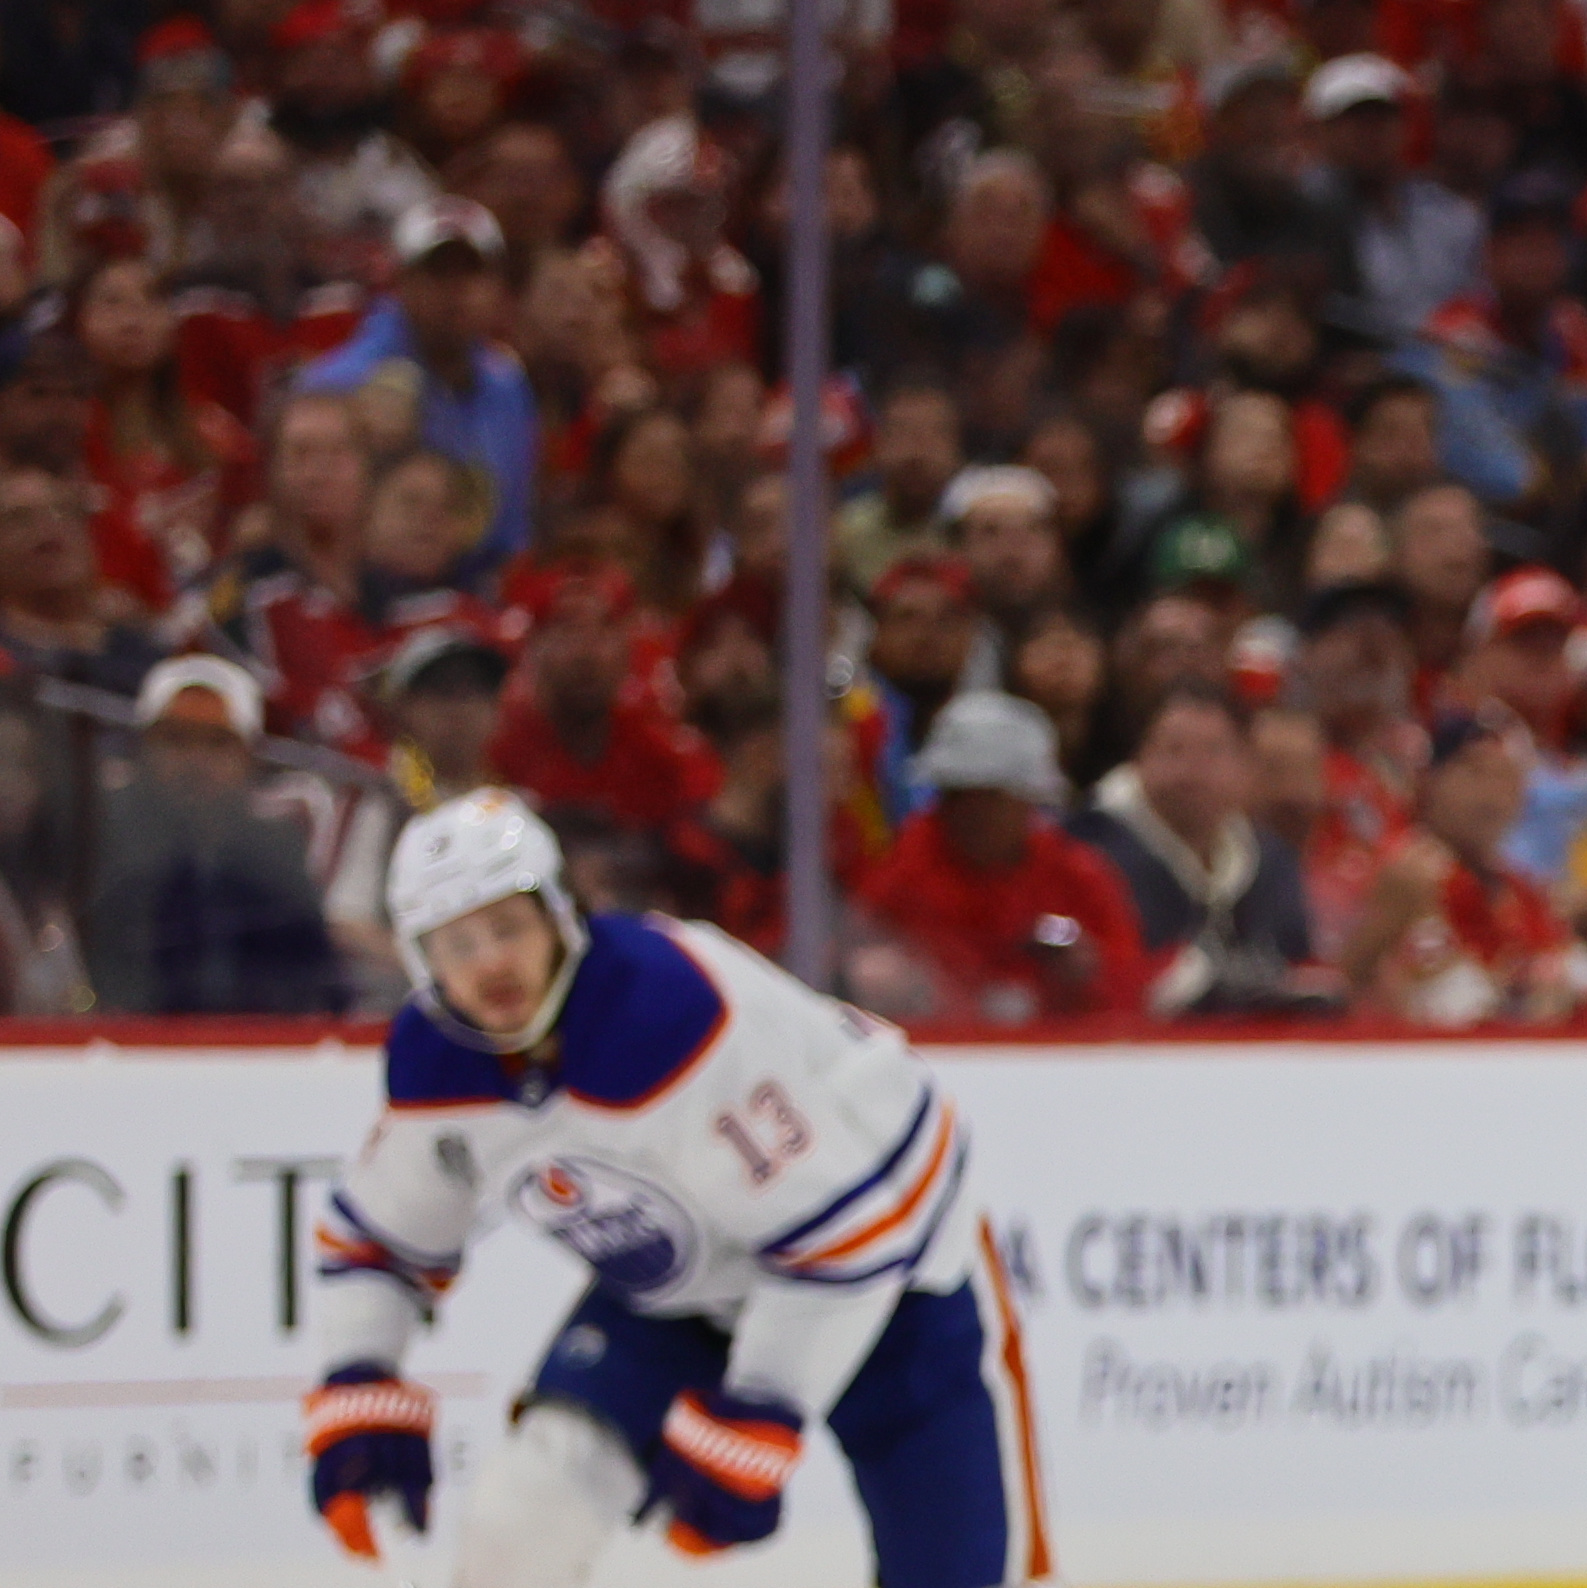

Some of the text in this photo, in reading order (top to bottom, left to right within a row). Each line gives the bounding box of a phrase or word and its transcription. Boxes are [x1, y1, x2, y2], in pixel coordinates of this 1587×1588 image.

[711, 1079, 813, 1188] 13
[2, 1158, 345, 1346] CIT
[1064, 1214, 1378, 1310] CENTERS
[1402, 1214, 1490, 1308] OF
[1082, 1336, 1272, 1430] Proven
[1298, 1336, 1480, 1424] Autism
